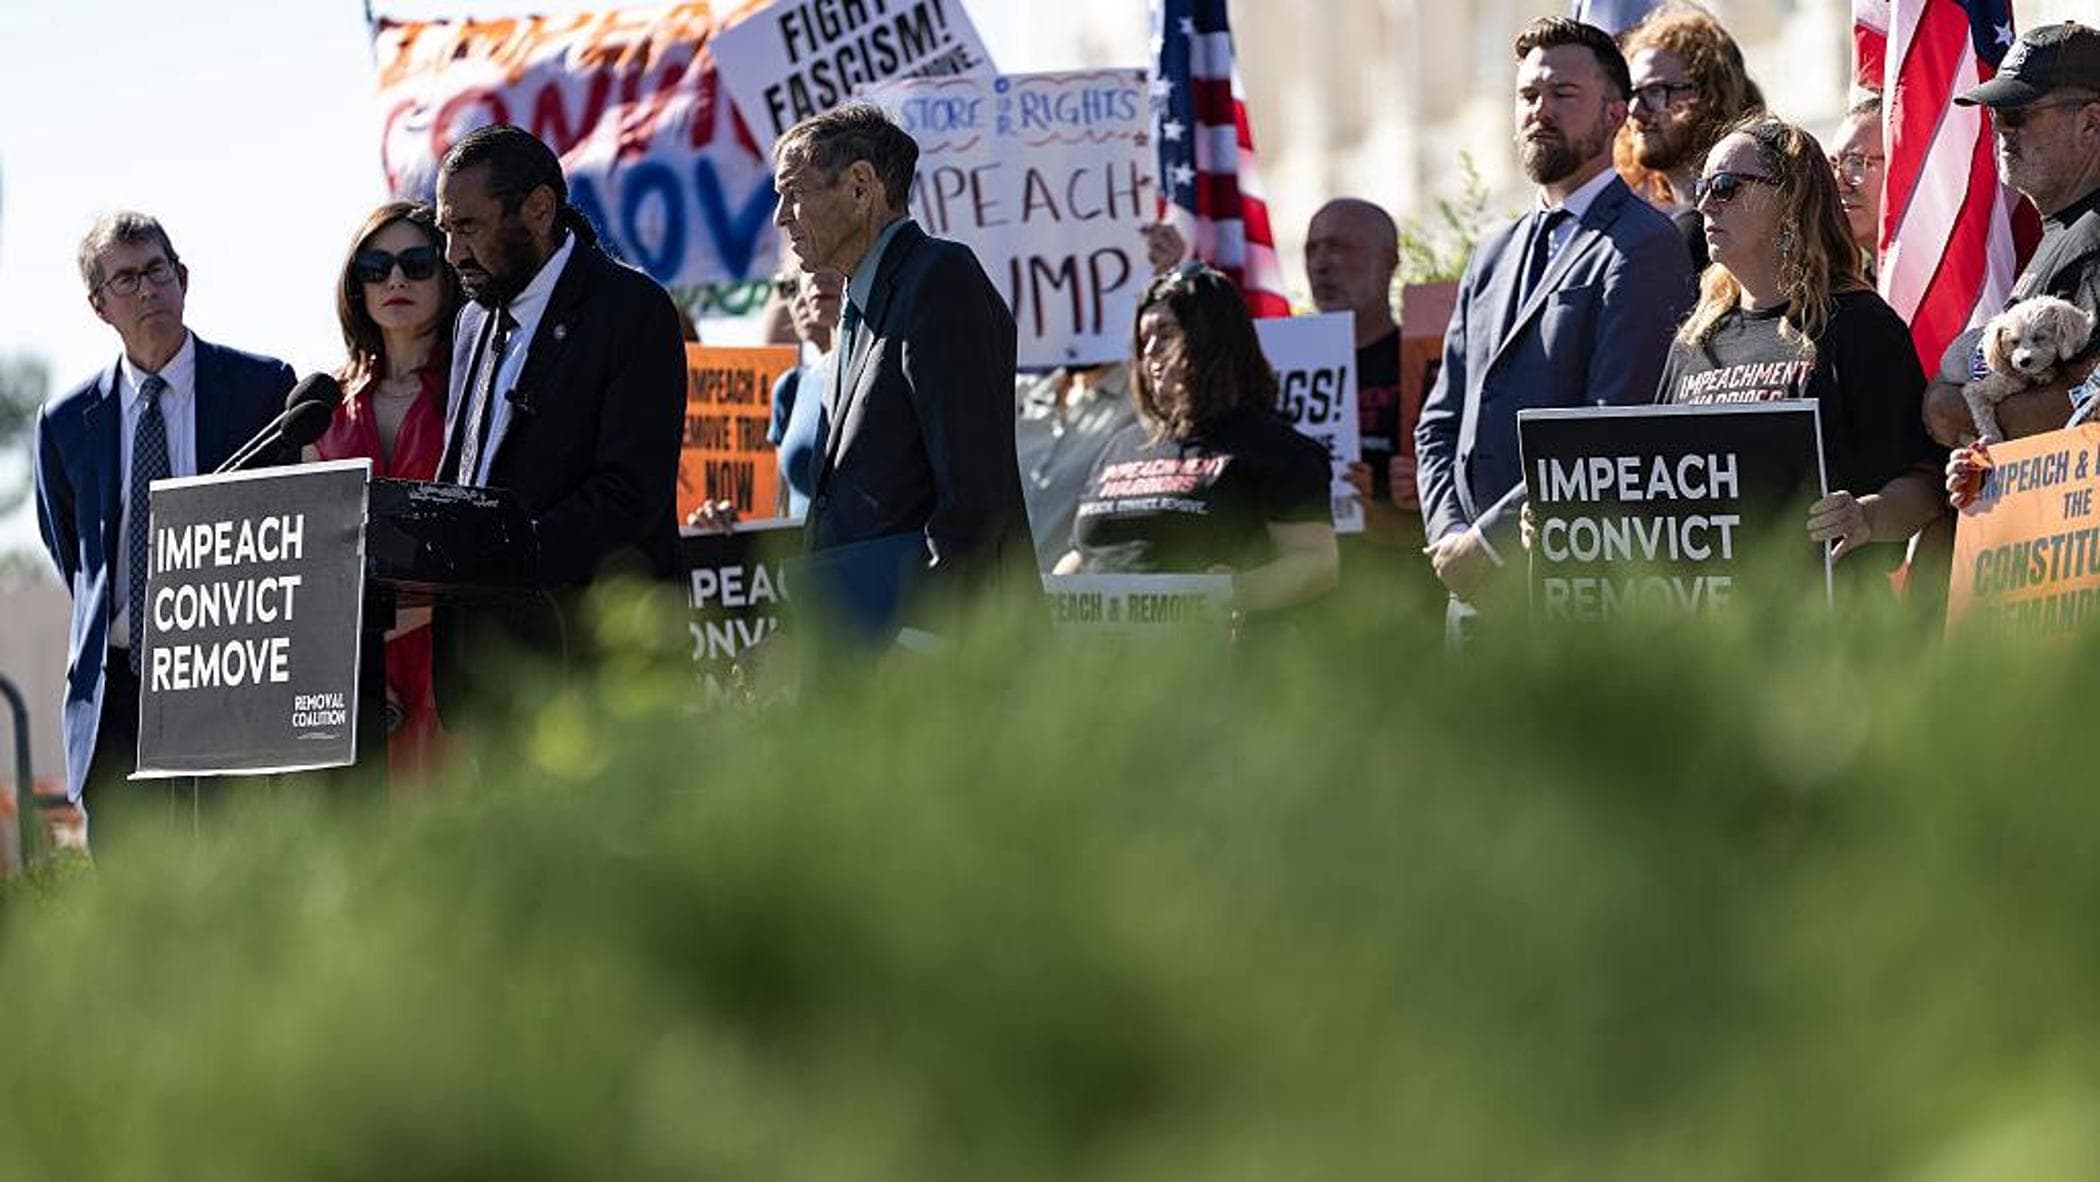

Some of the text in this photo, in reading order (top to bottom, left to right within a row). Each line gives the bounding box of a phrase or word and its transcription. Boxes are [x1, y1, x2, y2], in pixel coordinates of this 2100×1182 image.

[763, 0, 954, 136] FASCISM!
[1018, 88, 1140, 131] RIGHTS
[1282, 365, 1346, 425] GS!
[1680, 360, 1811, 401] IMPEACHMENT
[705, 460, 755, 513] NOW
[1537, 452, 1740, 503] IMPEACH
[1982, 449, 2070, 501] IMPEACH
[2074, 449, 2089, 480] &
[2063, 486, 2093, 520] THE
[157, 513, 305, 573] IMPEACH
[1541, 514, 1740, 563] CONVICT
[1974, 526, 2100, 596] CONSTITU
[153, 575, 302, 633] CONVICT
[1543, 575, 1732, 624] REMOVE
[151, 636, 290, 693] REMOVE
[292, 709, 346, 727] COALITION
[294, 692, 345, 711] REMOVAL
